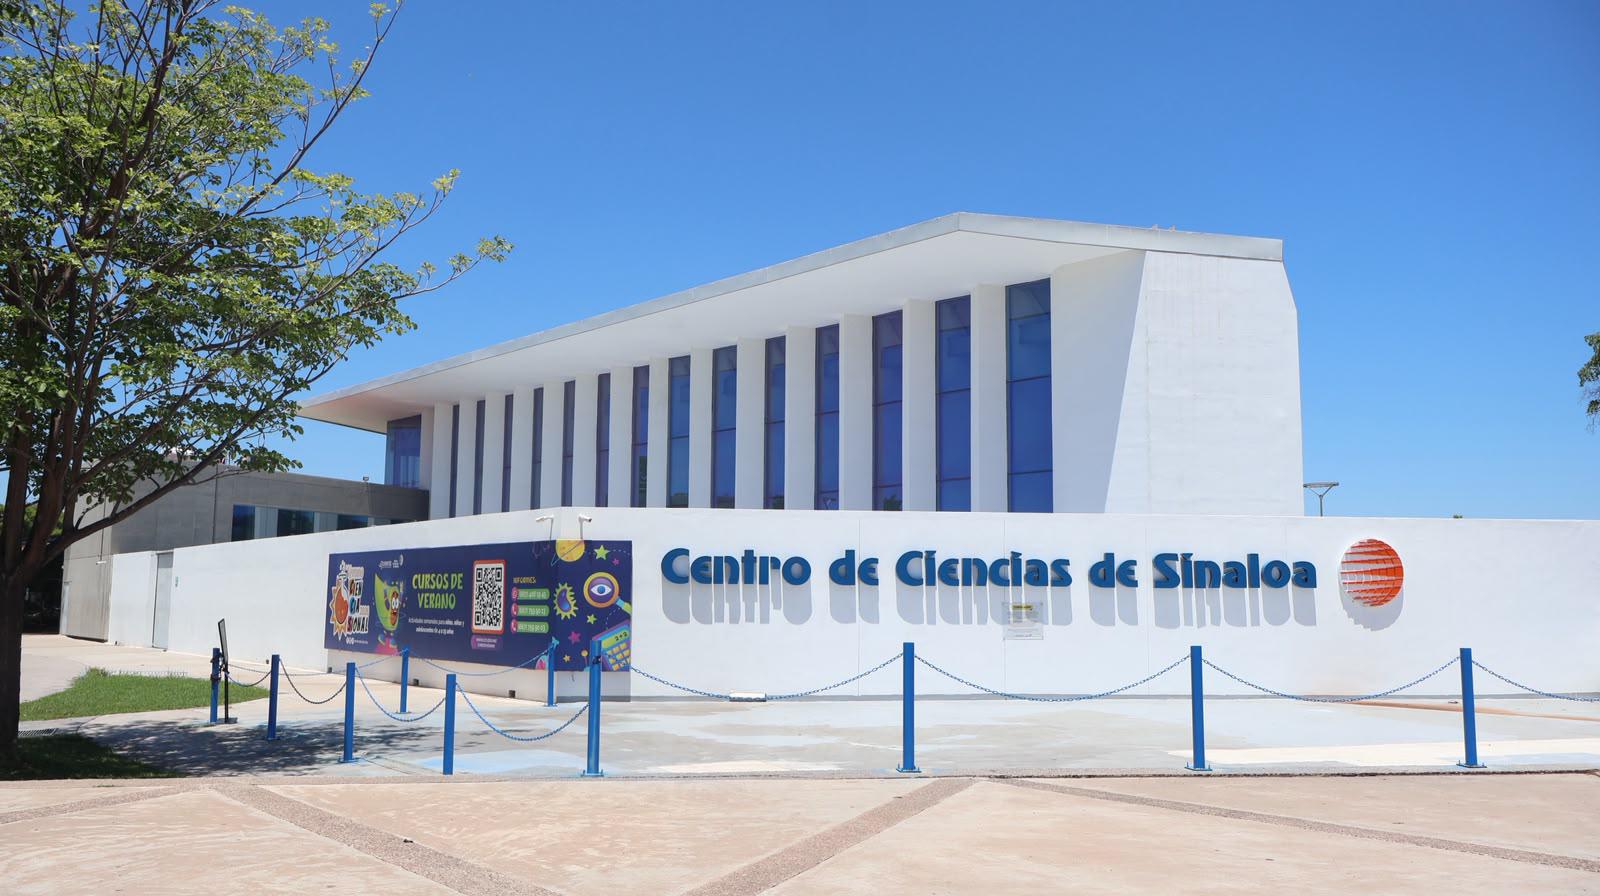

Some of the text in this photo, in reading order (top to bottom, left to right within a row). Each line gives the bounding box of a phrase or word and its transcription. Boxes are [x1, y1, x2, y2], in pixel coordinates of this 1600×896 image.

[662, 548, 1318, 589] Centro de Ciencias de Sinaloa
[412, 573, 464, 590] CURSOS DE
[417, 593, 456, 610] VERANO
